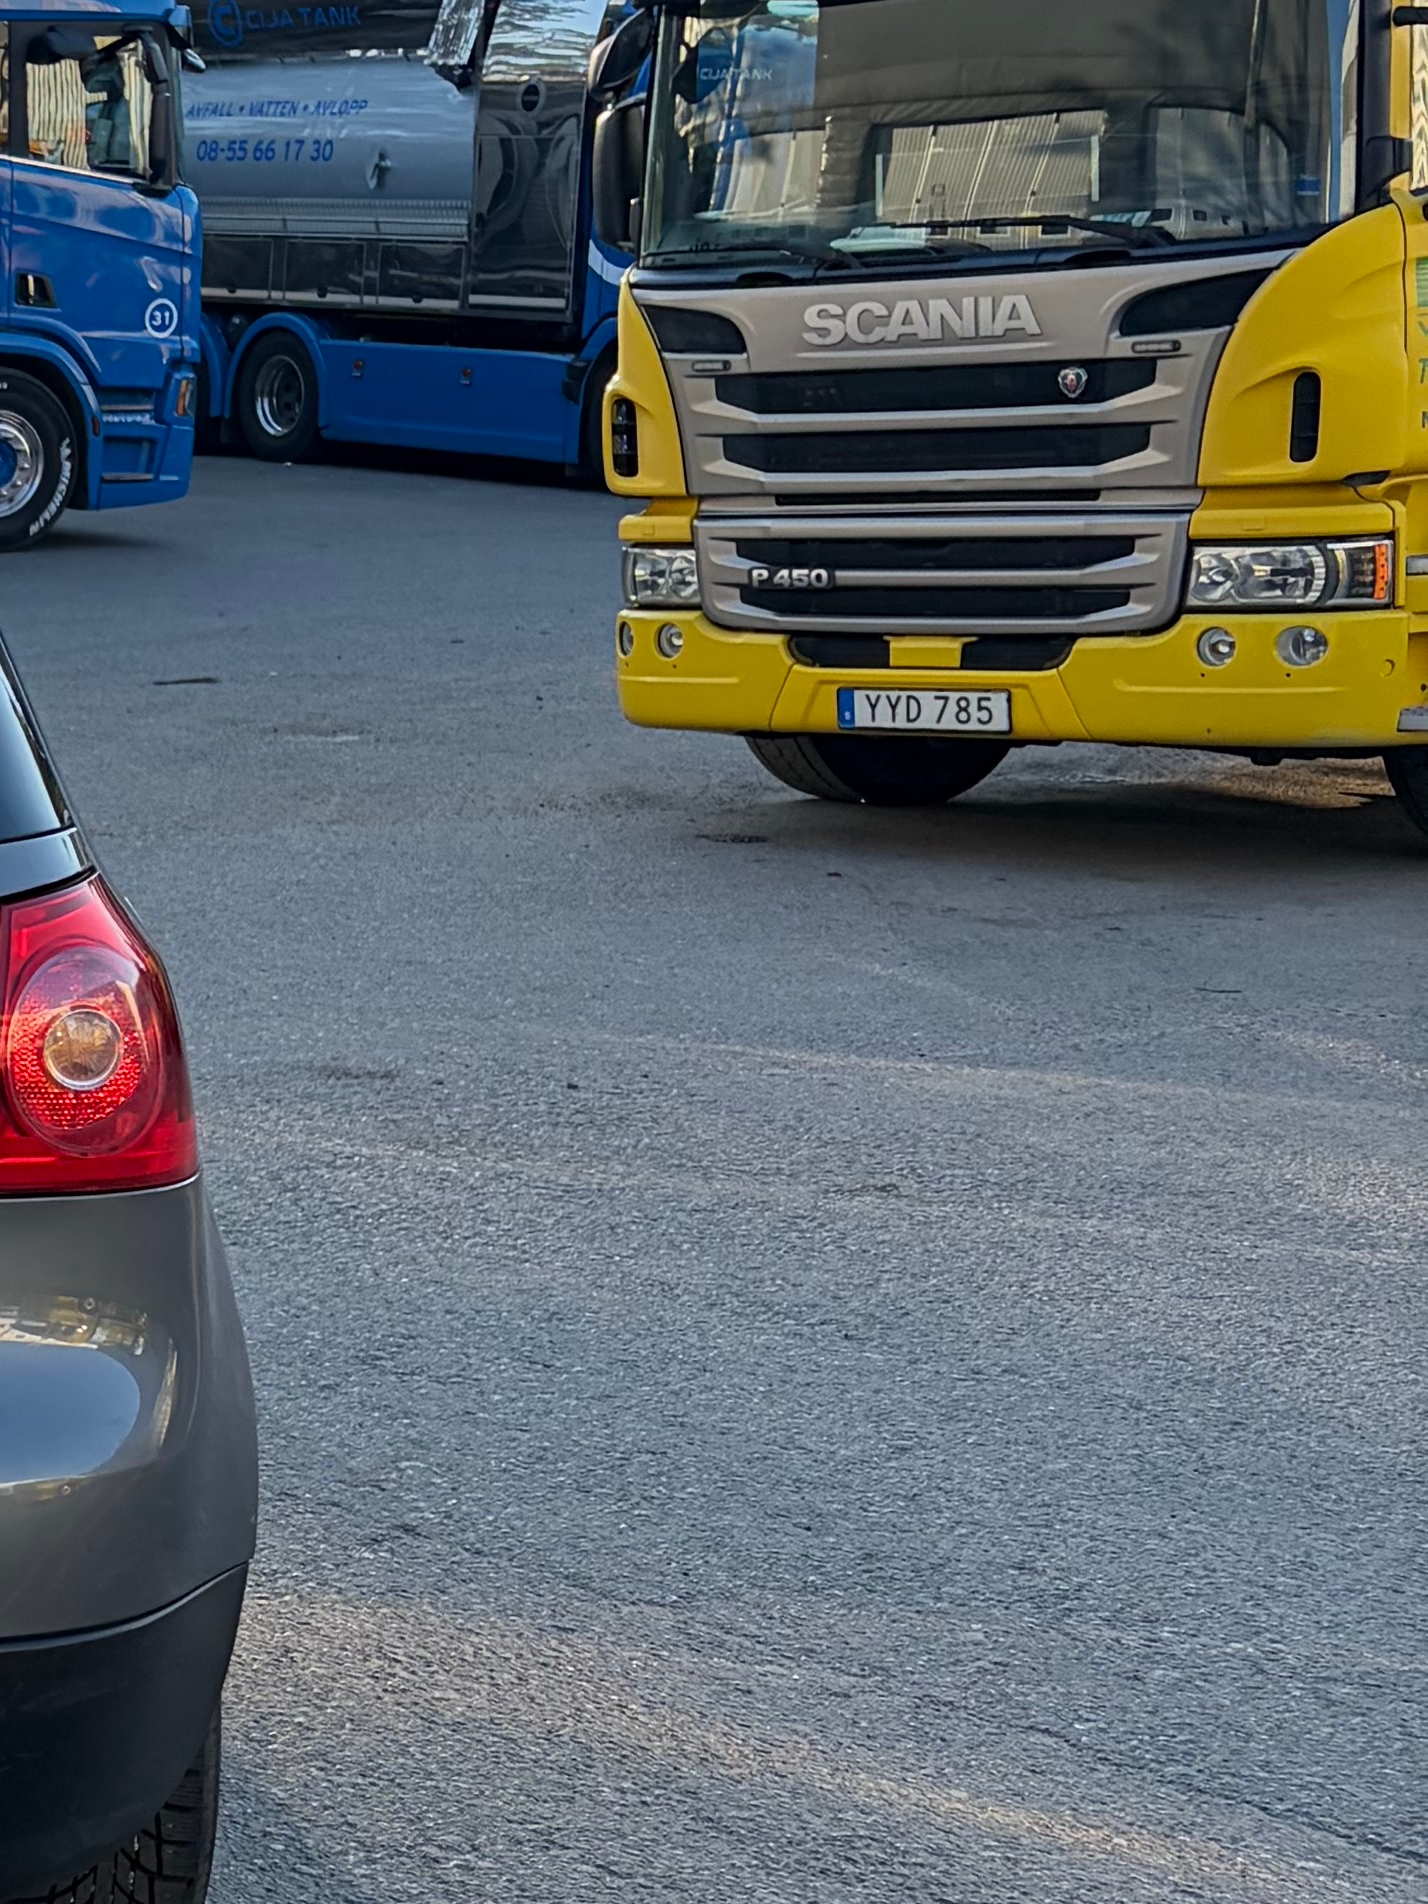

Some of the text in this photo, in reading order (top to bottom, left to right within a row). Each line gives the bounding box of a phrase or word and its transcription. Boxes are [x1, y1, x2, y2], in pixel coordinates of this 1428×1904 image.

[246, 6, 361, 29] CIJA TANK
[185, 99, 369, 118] AVFALL VATTEN AVLOPP
[196, 139, 334, 162] 08-55 66 17 30
[151, 310, 170, 327] 31
[802, 294, 1042, 346] SCANIA
[751, 568, 829, 589] P 450
[864, 693, 993, 725] YYD 785
